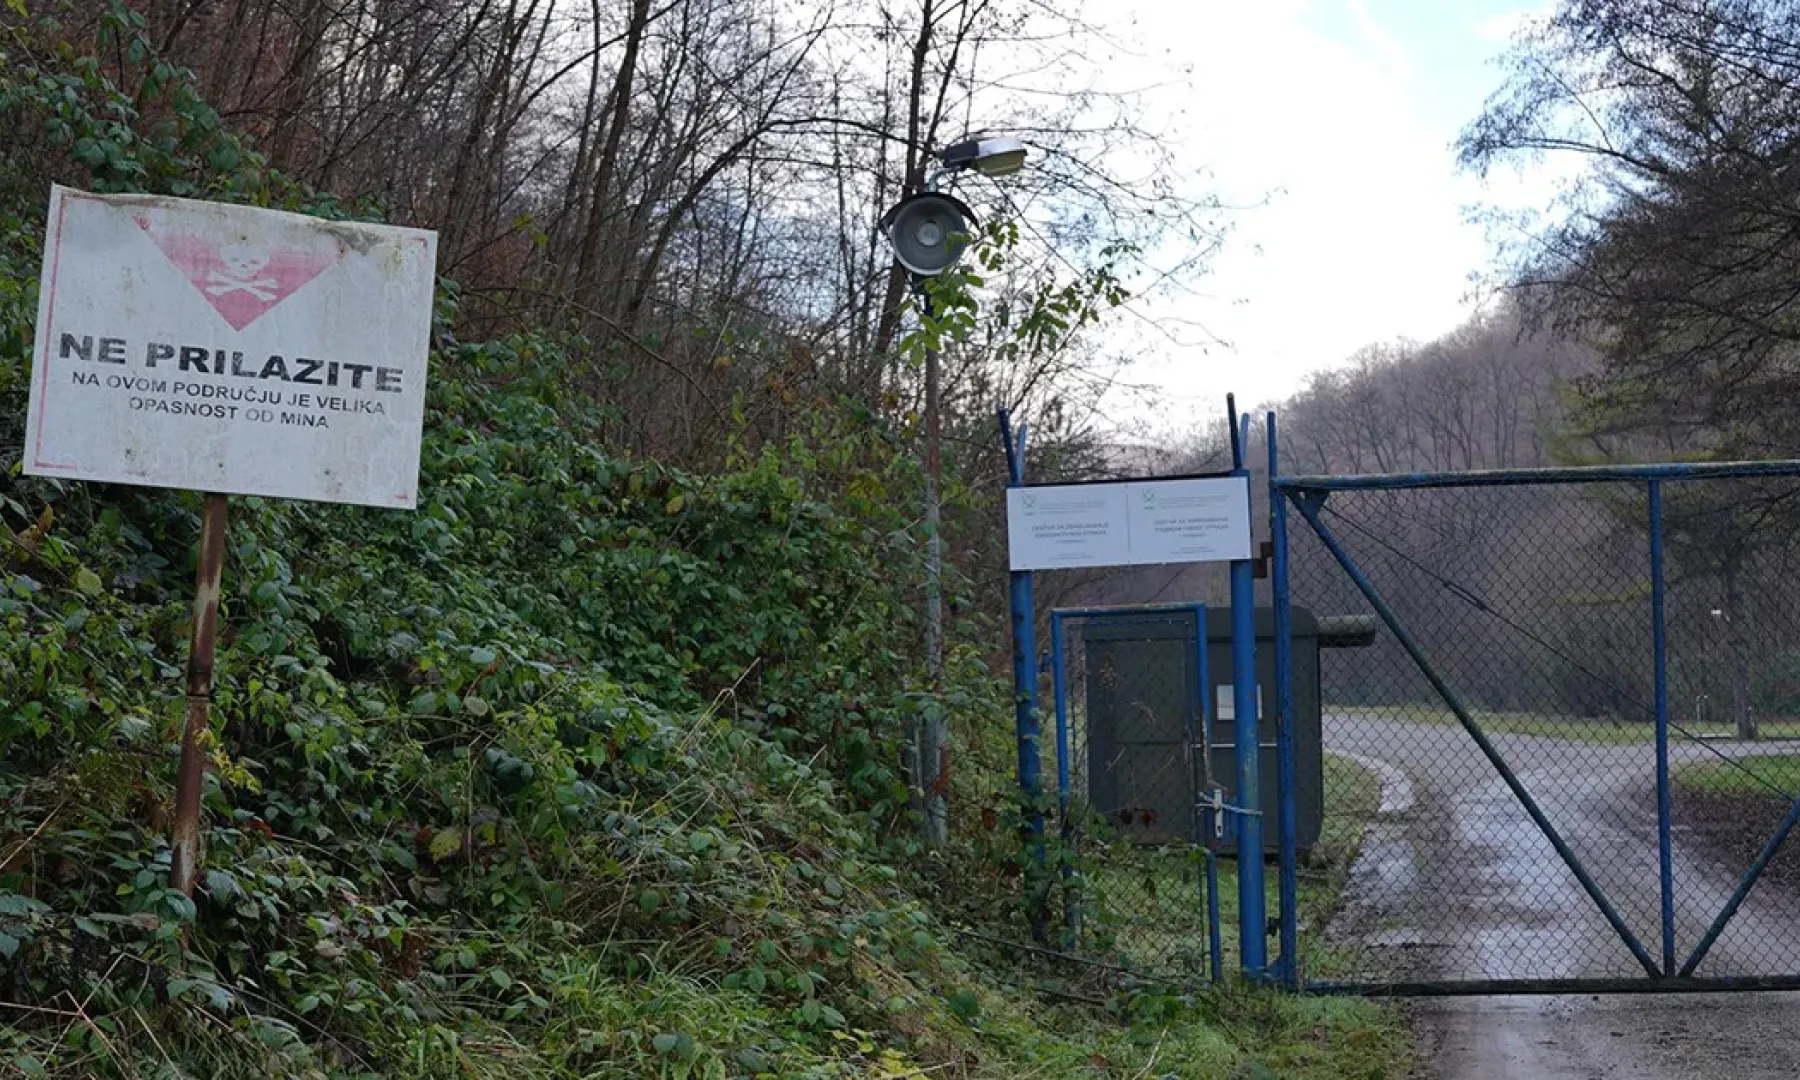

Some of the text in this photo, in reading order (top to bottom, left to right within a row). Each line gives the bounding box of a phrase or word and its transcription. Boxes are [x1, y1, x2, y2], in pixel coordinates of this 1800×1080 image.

[59, 332, 404, 392] NE PRILAZITE
[72, 372, 385, 415] NA OVOM PODRUČJU JE VELIKA
[129, 397, 329, 428] OPASNOST OD MINA
